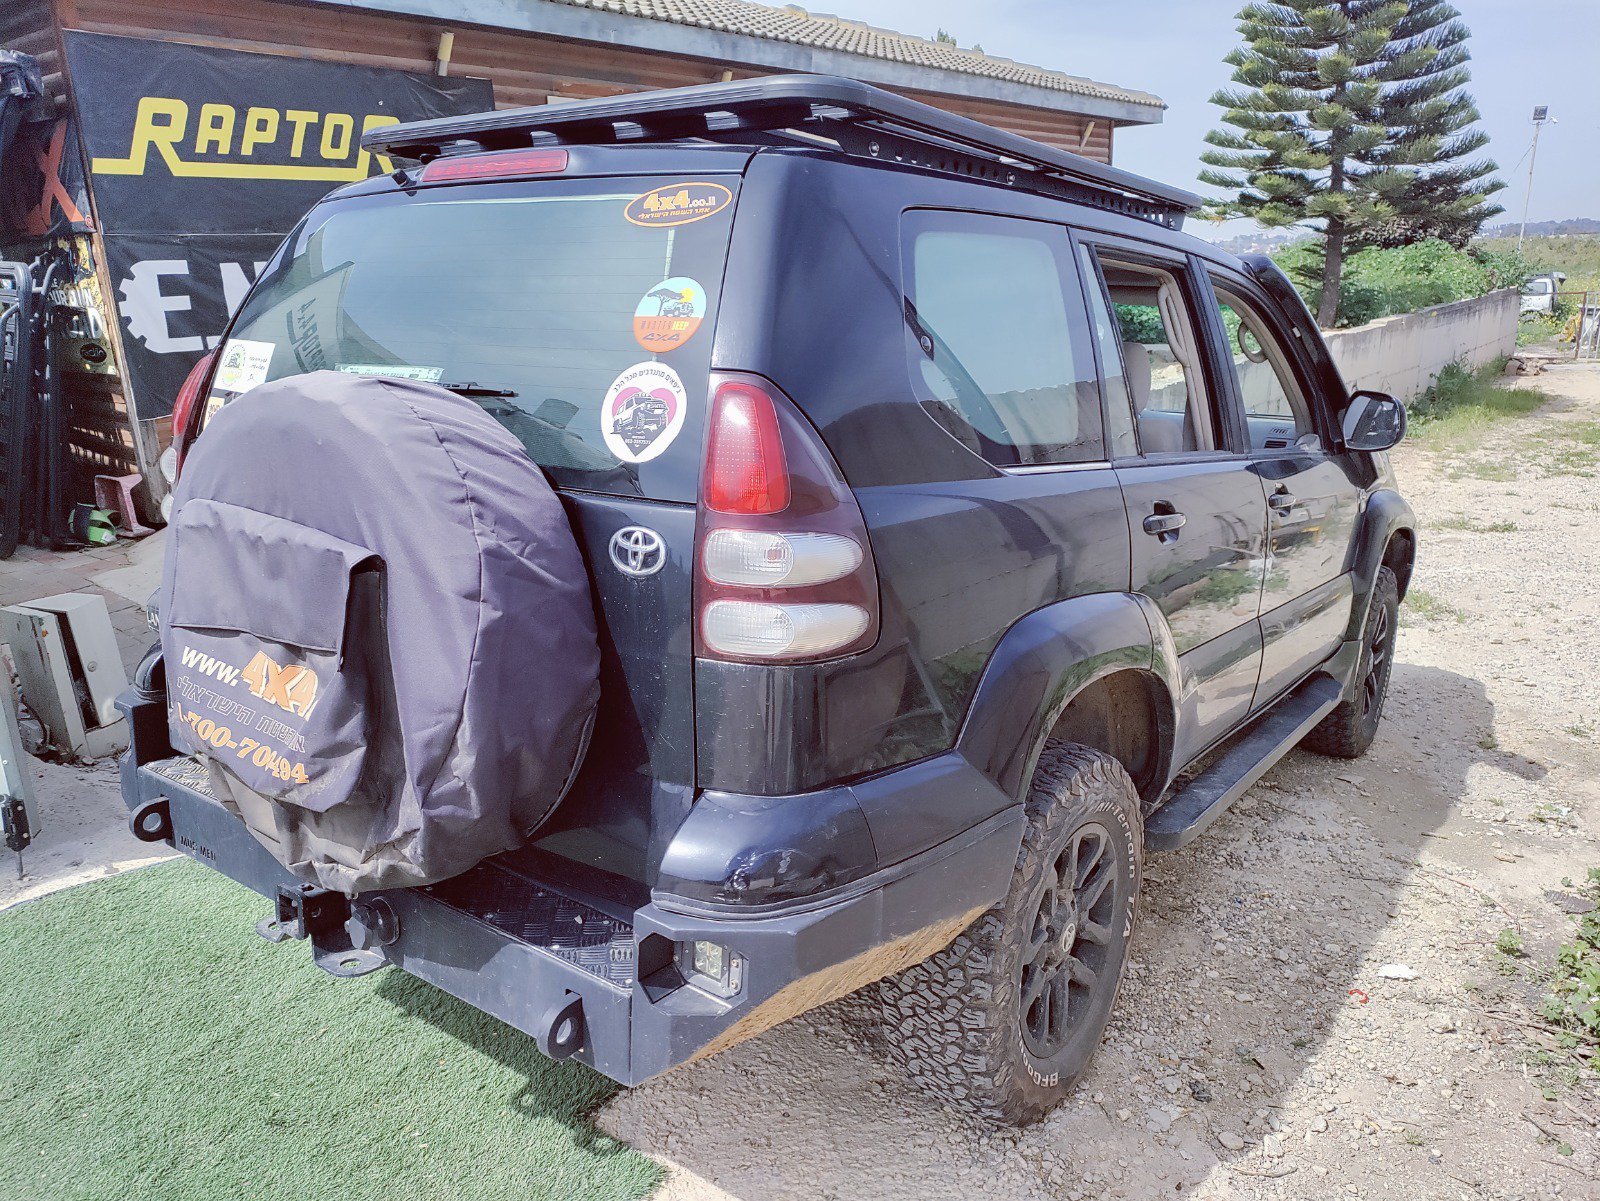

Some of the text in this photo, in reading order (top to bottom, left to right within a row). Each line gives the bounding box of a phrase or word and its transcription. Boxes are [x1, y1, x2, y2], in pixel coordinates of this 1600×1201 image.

[122, 97, 400, 181] RAPTOR
[1094, 801, 1137, 937] All-Terrain T/A
